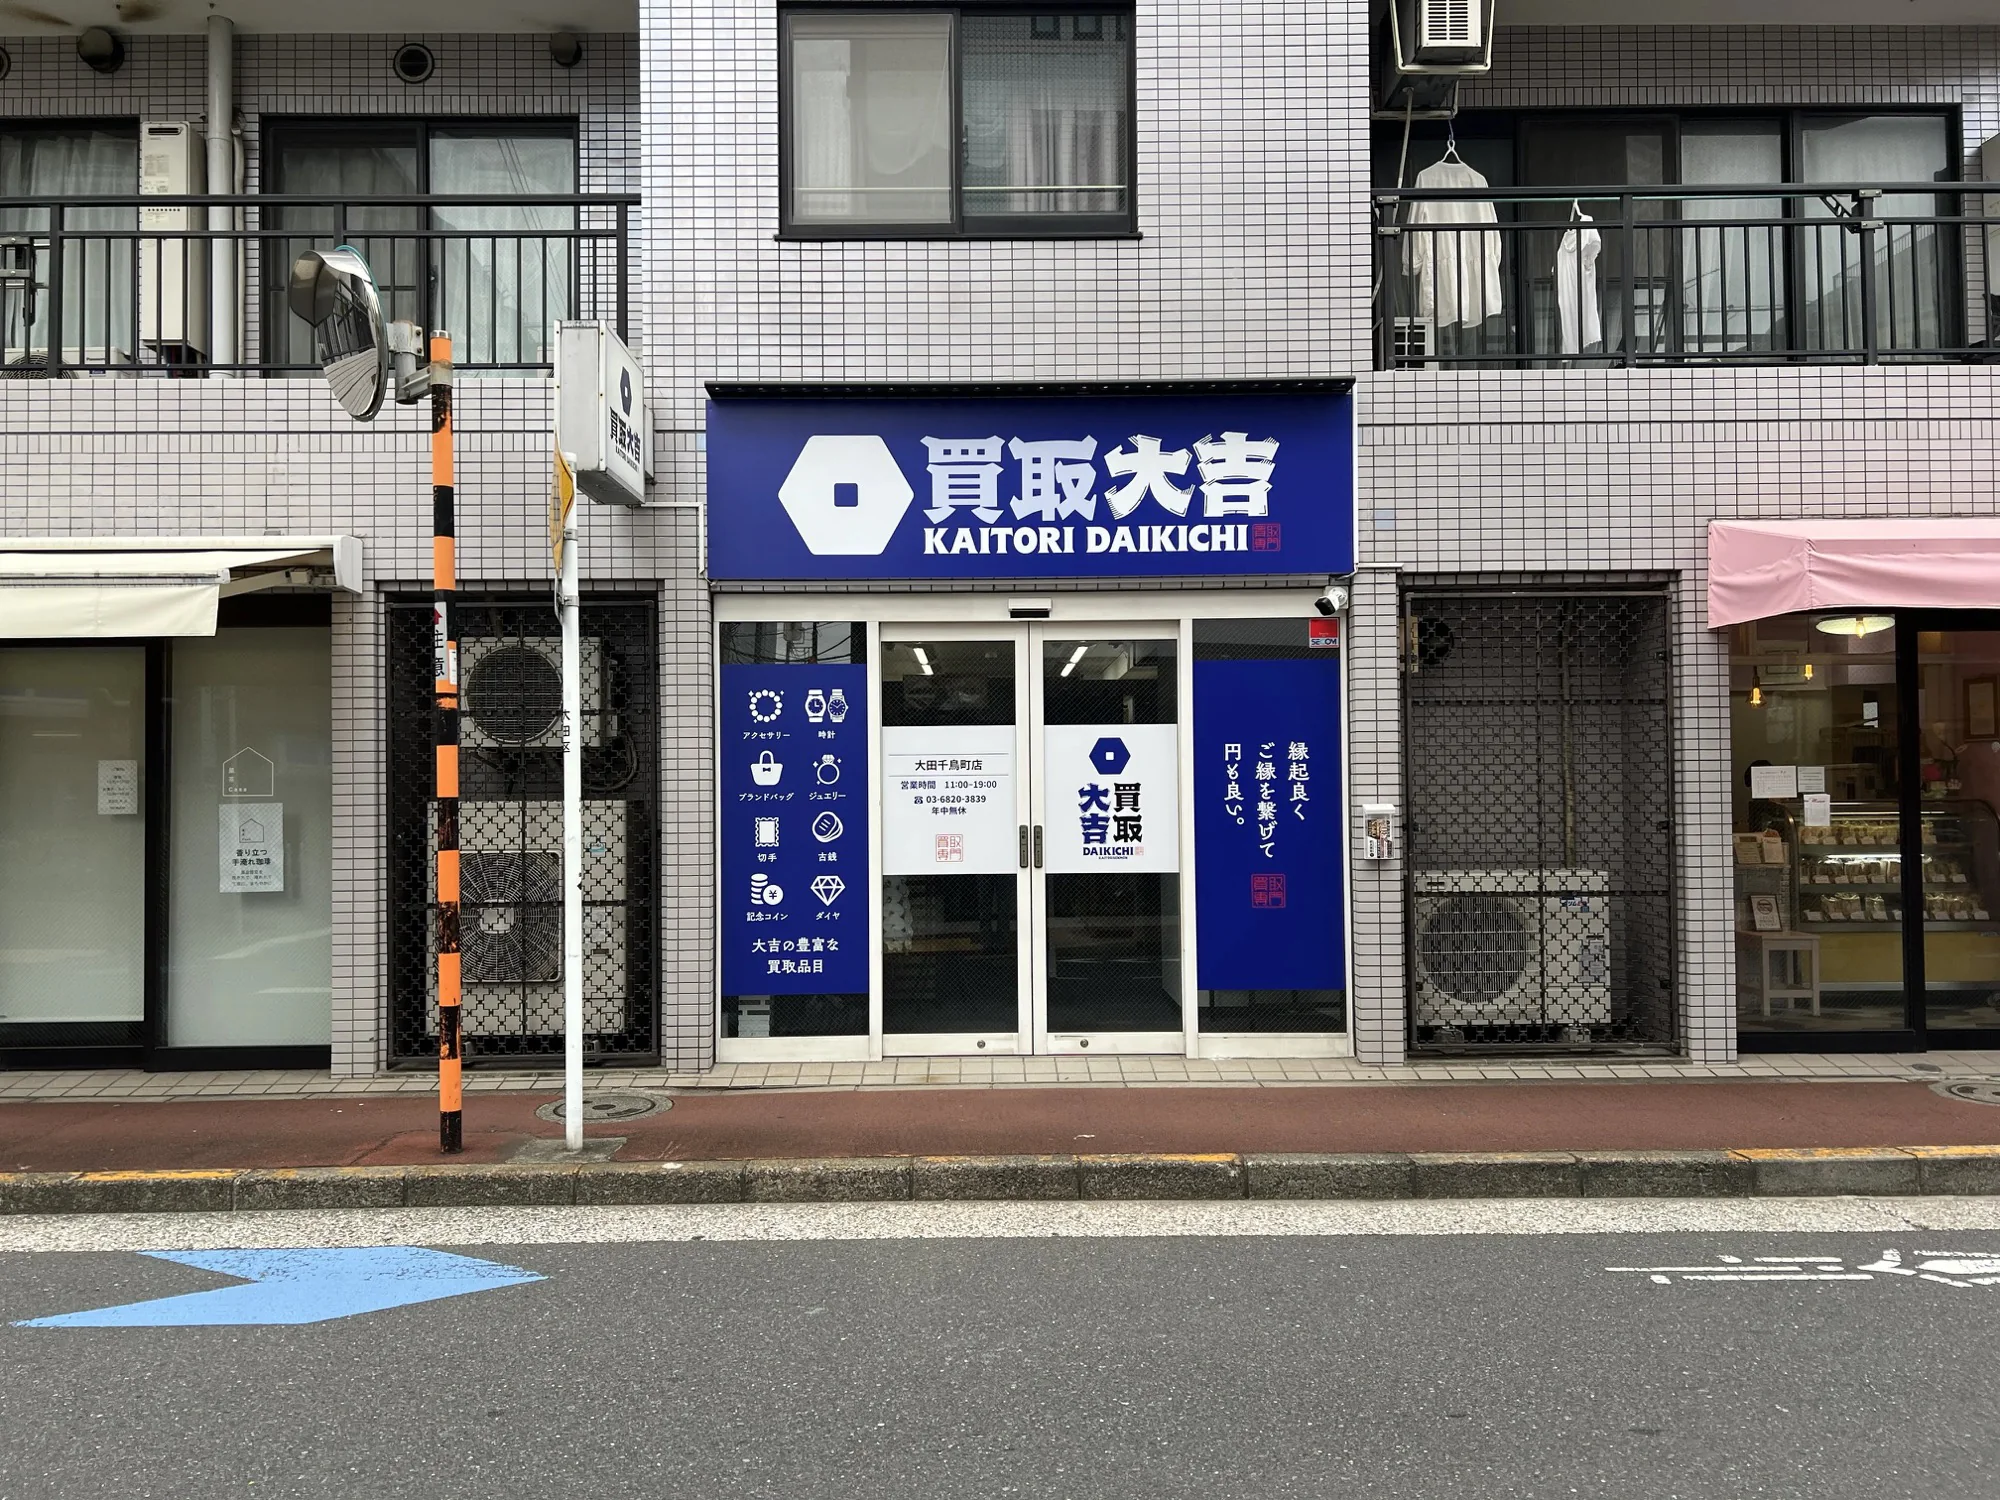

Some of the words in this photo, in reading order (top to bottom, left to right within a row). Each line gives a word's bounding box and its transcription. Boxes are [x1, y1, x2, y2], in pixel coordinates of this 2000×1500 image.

[920, 431, 1281, 524] 買取大吉
[923, 526, 1075, 554] KAITORI
[1086, 524, 1249, 554] DAIKICHI
[1311, 638, 1337, 646] SECOM
[743, 731, 791, 740] アクセサリー
[818, 730, 836, 739] 時計
[914, 759, 983, 771] 大田千鳥町店
[900, 780, 936, 790] 営業時間
[1223, 743, 1245, 826] 円も良い。
[1287, 741, 1310, 821] 縁起良く
[739, 792, 795, 802] ブランドバッグ
[809, 791, 847, 801] ジュエリー
[926, 795, 986, 804] 03-6820-3839
[1255, 742, 1278, 858] ご縁を繋げて
[931, 806, 967, 815] 年中無休
[1078, 782, 1111, 845] 大吉
[1112, 782, 1143, 843] 買取
[1082, 846, 1134, 856] DAIKICHI
[757, 852, 778, 863] 切手
[818, 852, 838, 862] 古銭
[746, 911, 789, 922] 記念コイン
[815, 911, 841, 921] ダイヤ
[751, 937, 839, 953] 大吉の豊富な
[767, 959, 823, 975] 買取品目
